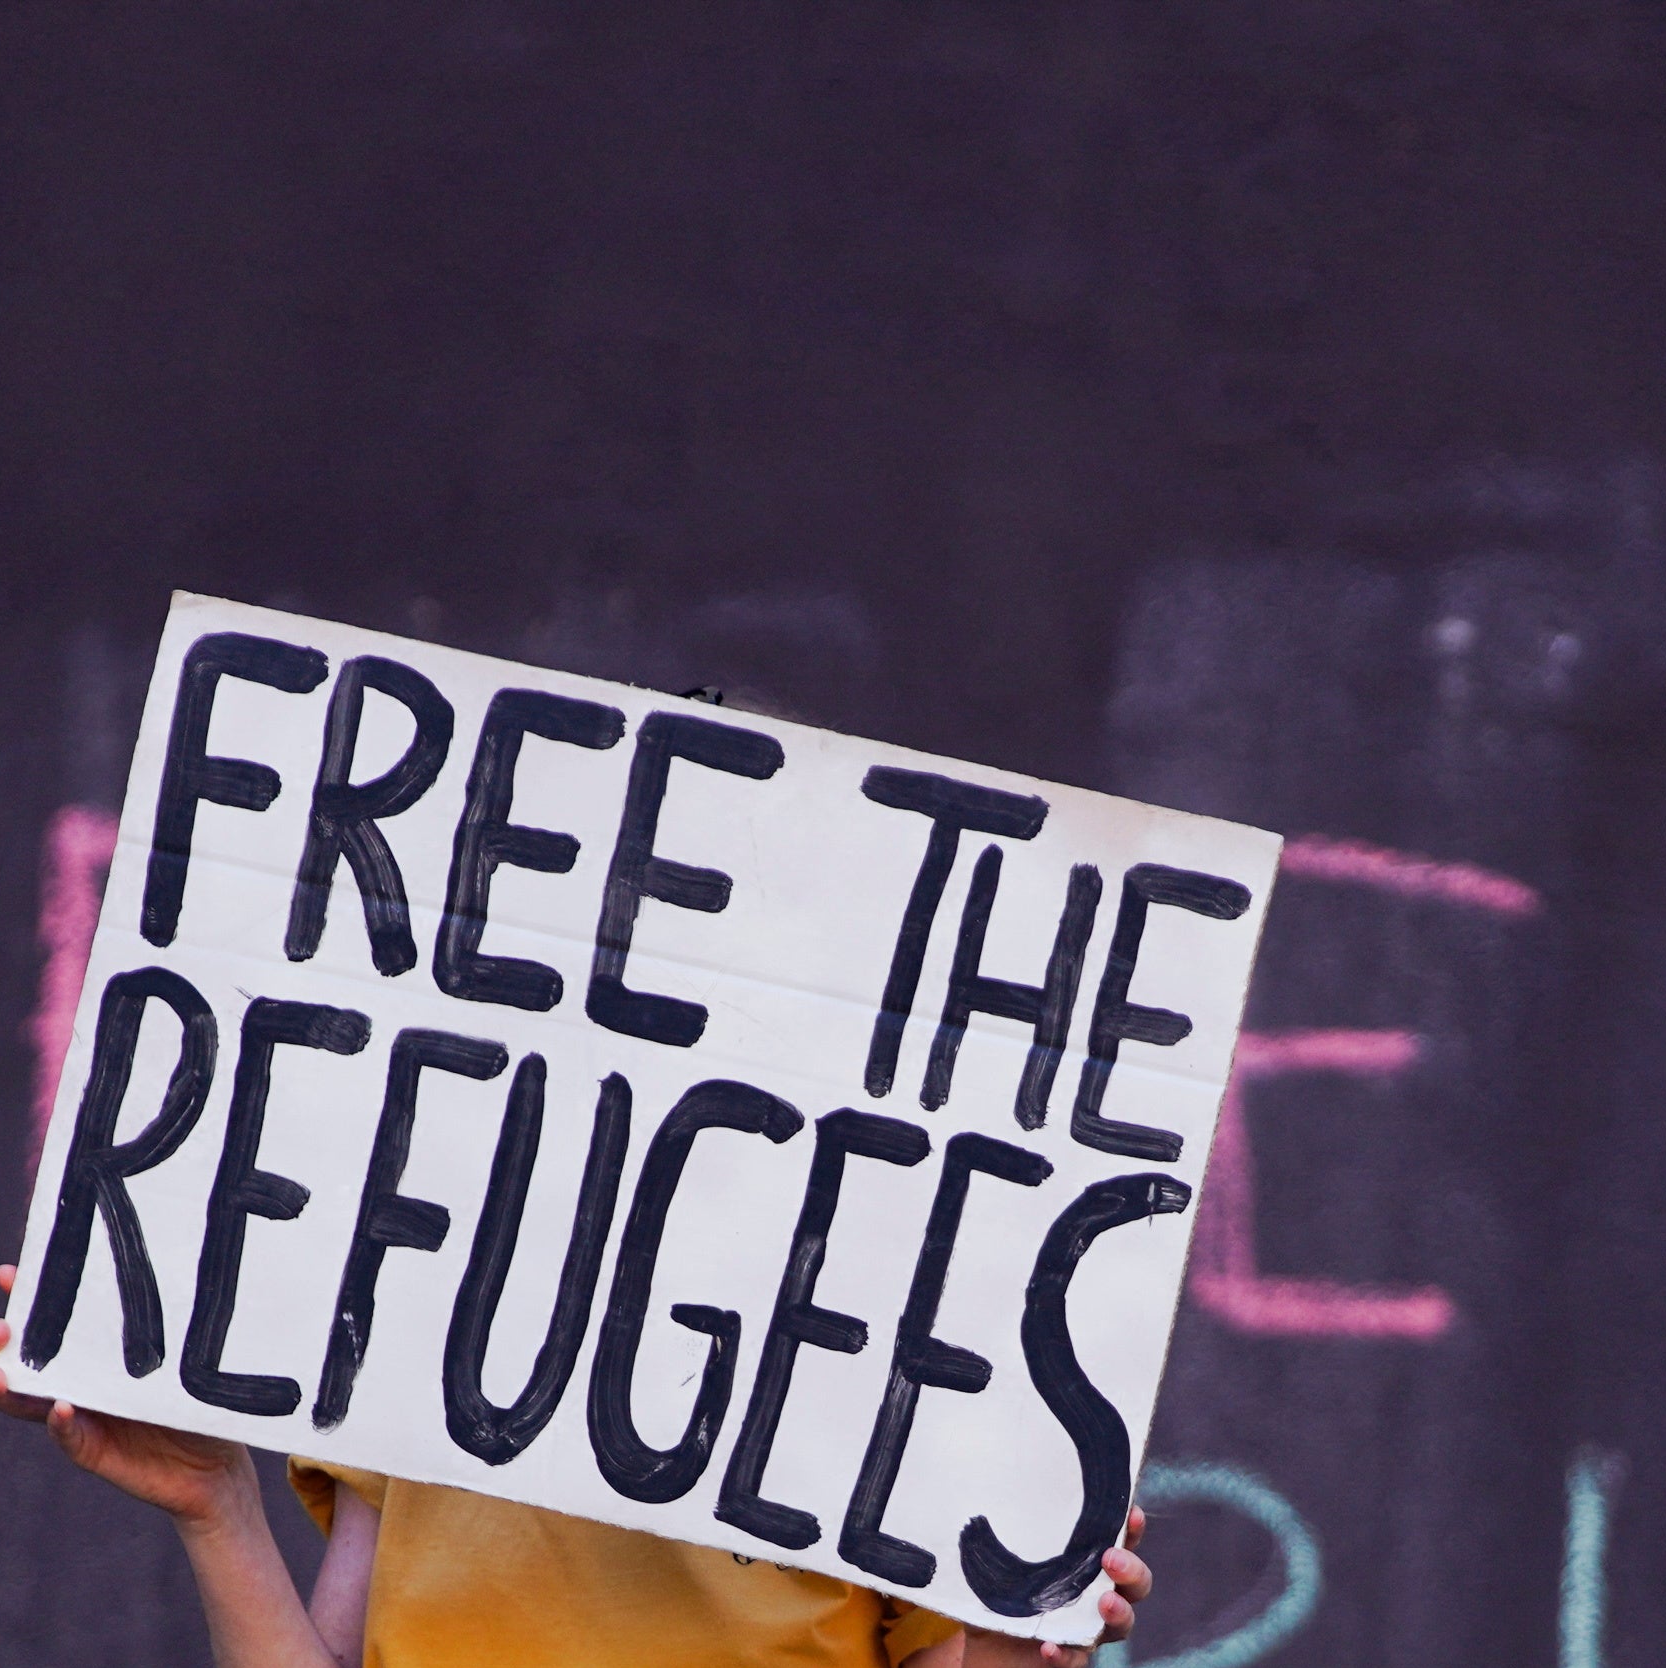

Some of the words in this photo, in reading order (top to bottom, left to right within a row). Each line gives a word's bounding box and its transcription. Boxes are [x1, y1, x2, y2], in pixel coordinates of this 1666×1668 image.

[141, 631, 785, 1047] FREE
[860, 764, 1252, 1161] THE
[19, 965, 1191, 1617] REFUGEES
